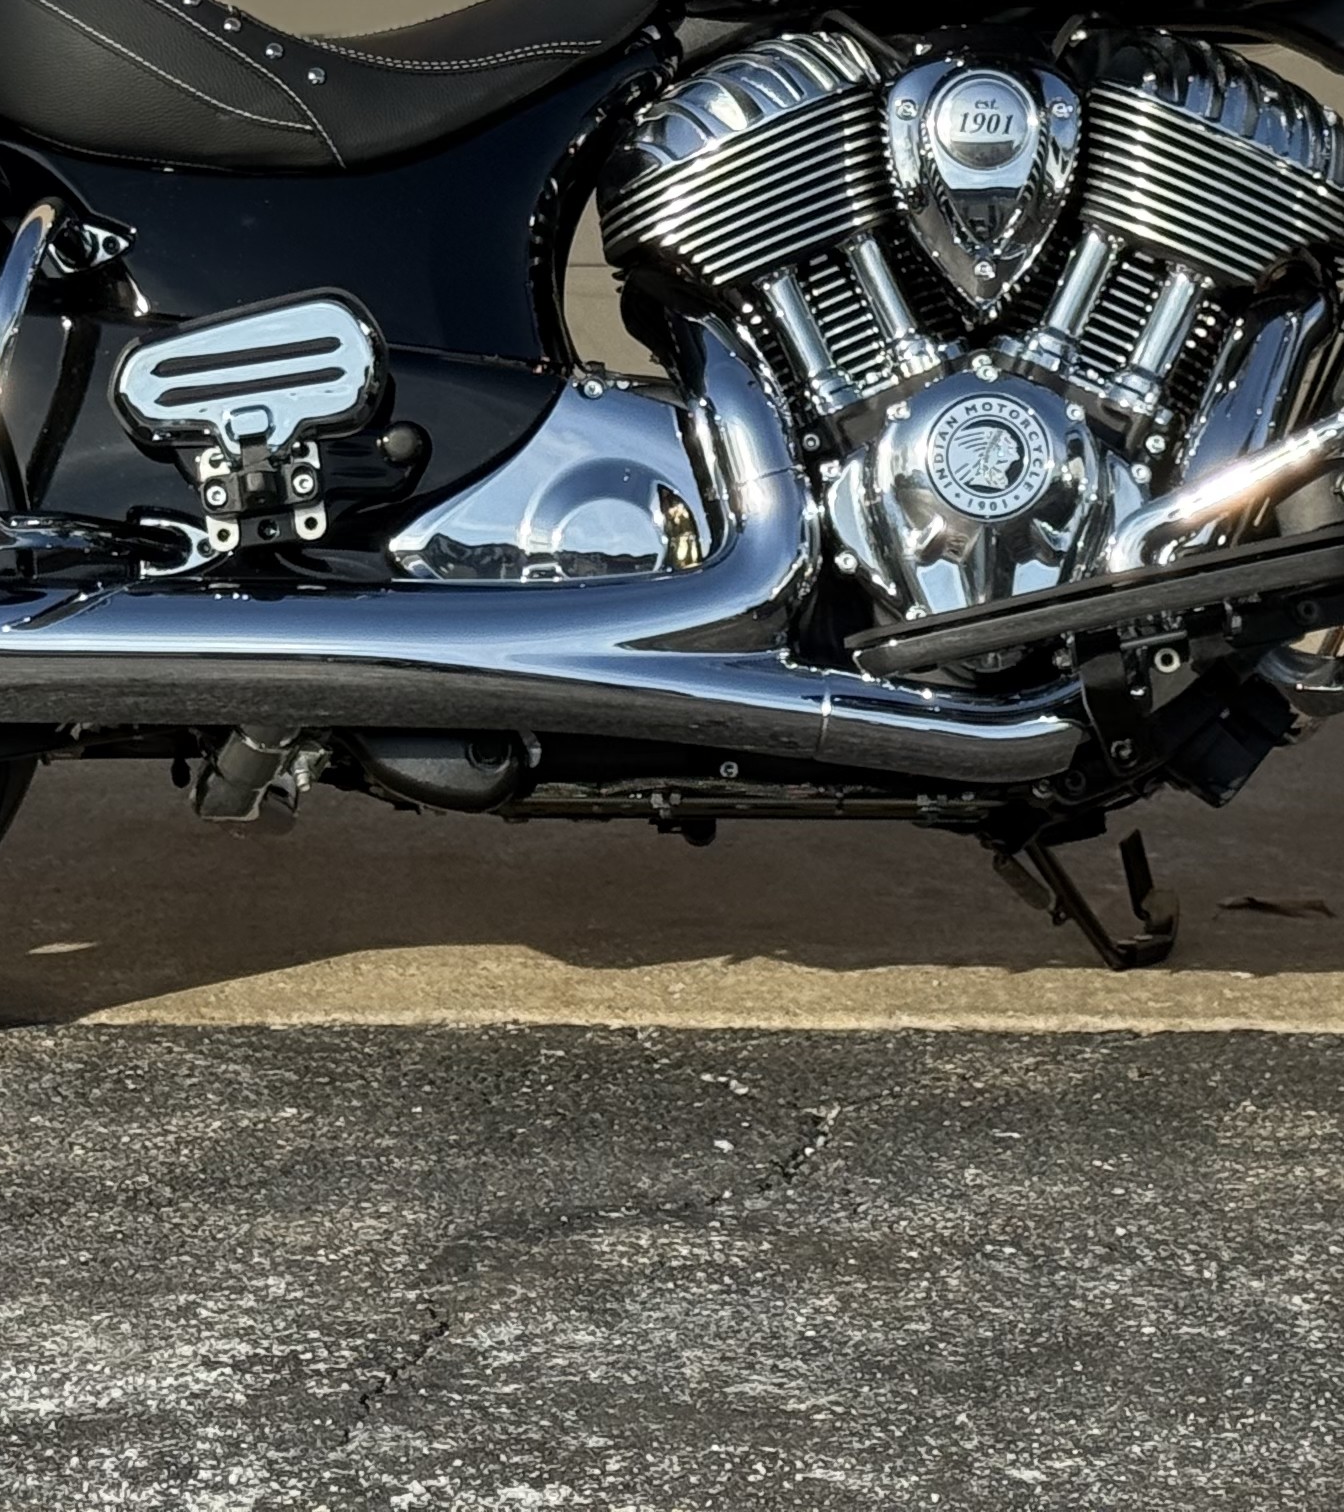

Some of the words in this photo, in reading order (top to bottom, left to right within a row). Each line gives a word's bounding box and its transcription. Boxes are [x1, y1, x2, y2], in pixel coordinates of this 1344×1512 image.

[958, 111, 1014, 136] 1901
[934, 415, 958, 489] INDIAN
[965, 401, 1043, 492] MOTORCYCLE
[966, 497, 1009, 512] 1901
